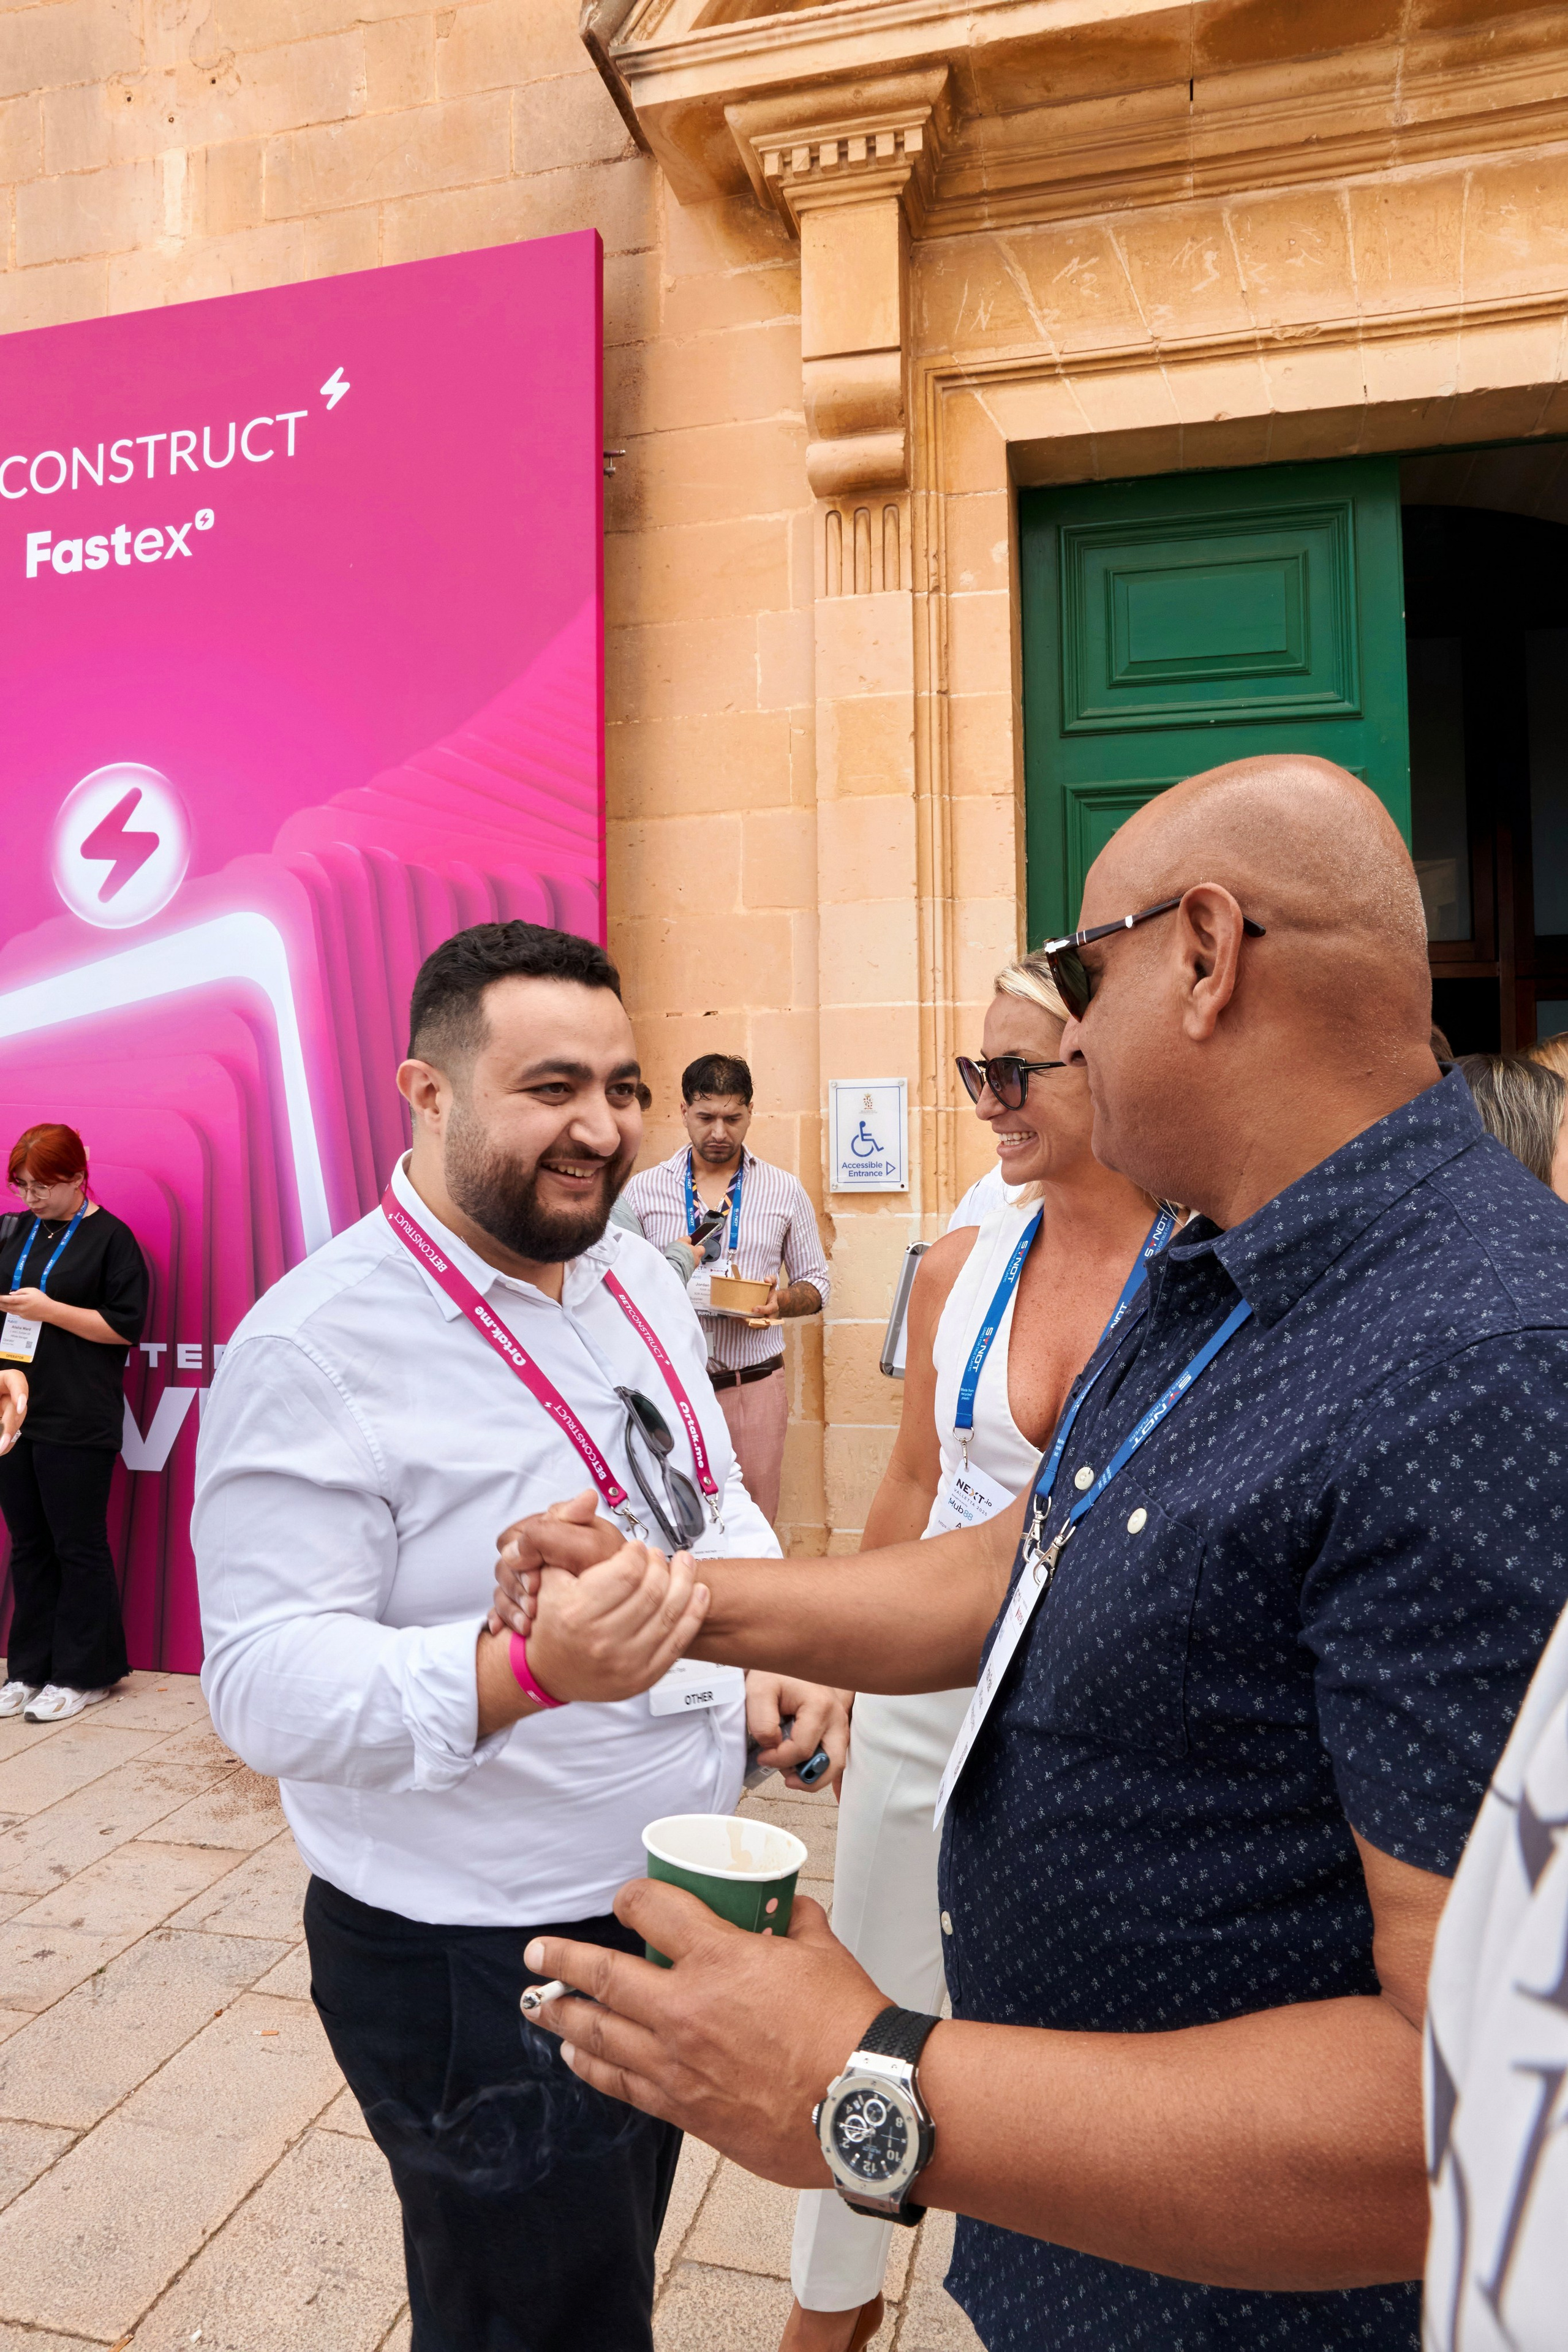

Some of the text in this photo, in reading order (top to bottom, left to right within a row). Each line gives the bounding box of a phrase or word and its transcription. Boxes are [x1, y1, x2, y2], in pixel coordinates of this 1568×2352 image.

[1, 410, 308, 499] CONSTRUCT
[26, 522, 193, 578] Fastex
[394, 1212, 448, 1273] BETCONSTRUCT
[1145, 1213, 1168, 1257] SYNOT
[1008, 1240, 1028, 1283] SYNOT
[474, 1306, 526, 1366] Ortak.me
[618, 1294, 663, 1359] BETCONSTRUCT
[973, 1327, 993, 1373] SYNOT
[1129, 1418, 1149, 1442] PLAYERS
[1132, 1374, 1191, 1449] SYNOT
[1148, 1403, 1161, 1419] TRUE
[554, 1405, 606, 1480] BETCONSTRUCT
[680, 1401, 704, 1468] Ortak.me
[948, 1498, 973, 1521] Hub88
[954, 1488, 987, 1516] VALLETTA 2025
[684, 1691, 714, 1705] OTHER
[842, 2137, 850, 2149] 2
[895, 2117, 903, 2128] 8
[862, 2160, 877, 2174] 12
[886, 2150, 900, 2162] 10
